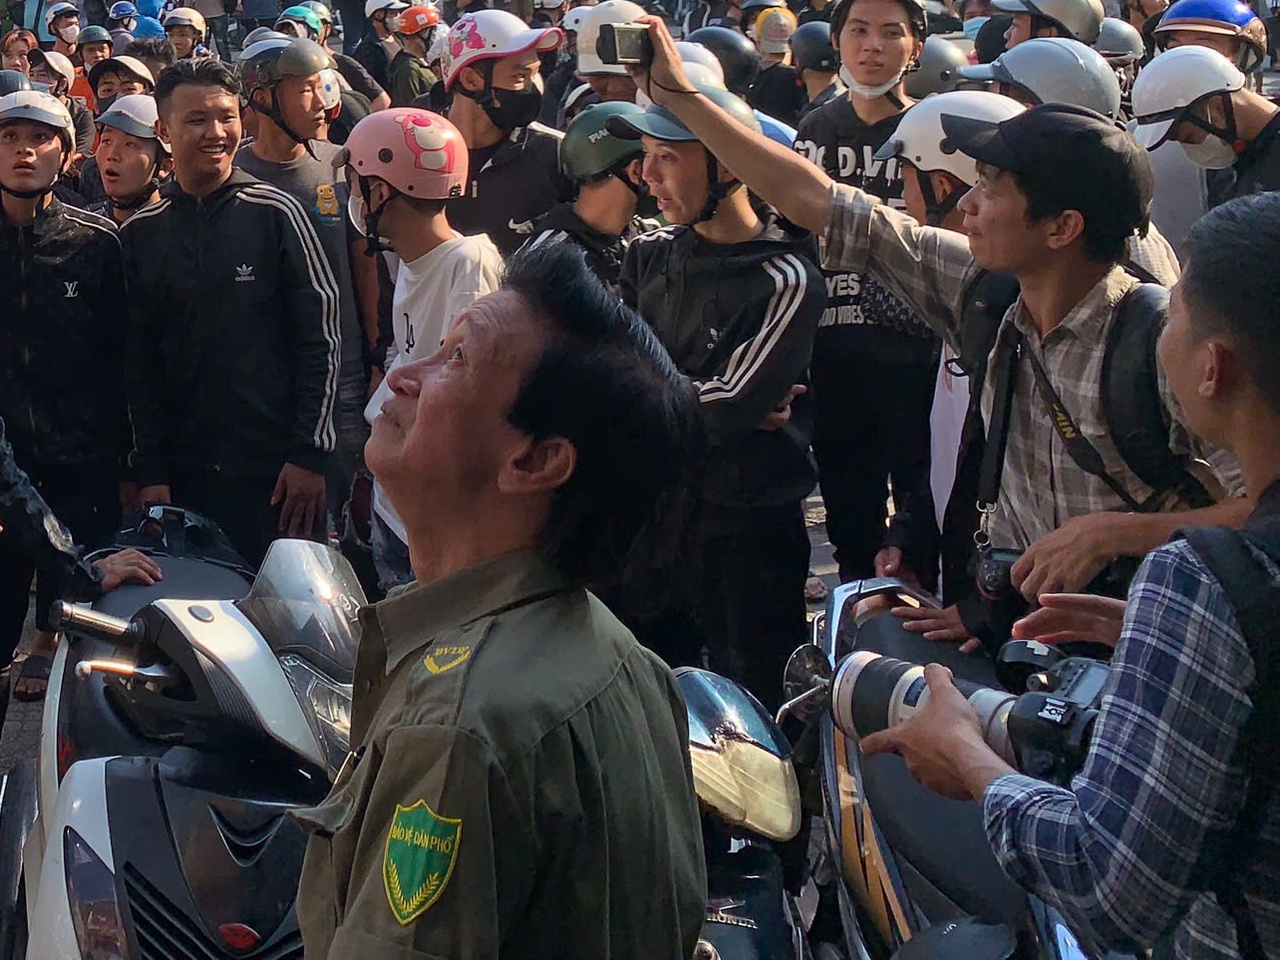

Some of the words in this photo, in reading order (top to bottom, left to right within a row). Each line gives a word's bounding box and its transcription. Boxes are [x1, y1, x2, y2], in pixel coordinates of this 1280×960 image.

[825, 273, 860, 297] YES
[414, 828, 429, 848] DÂN
[430, 834, 455, 853] PHỐ
